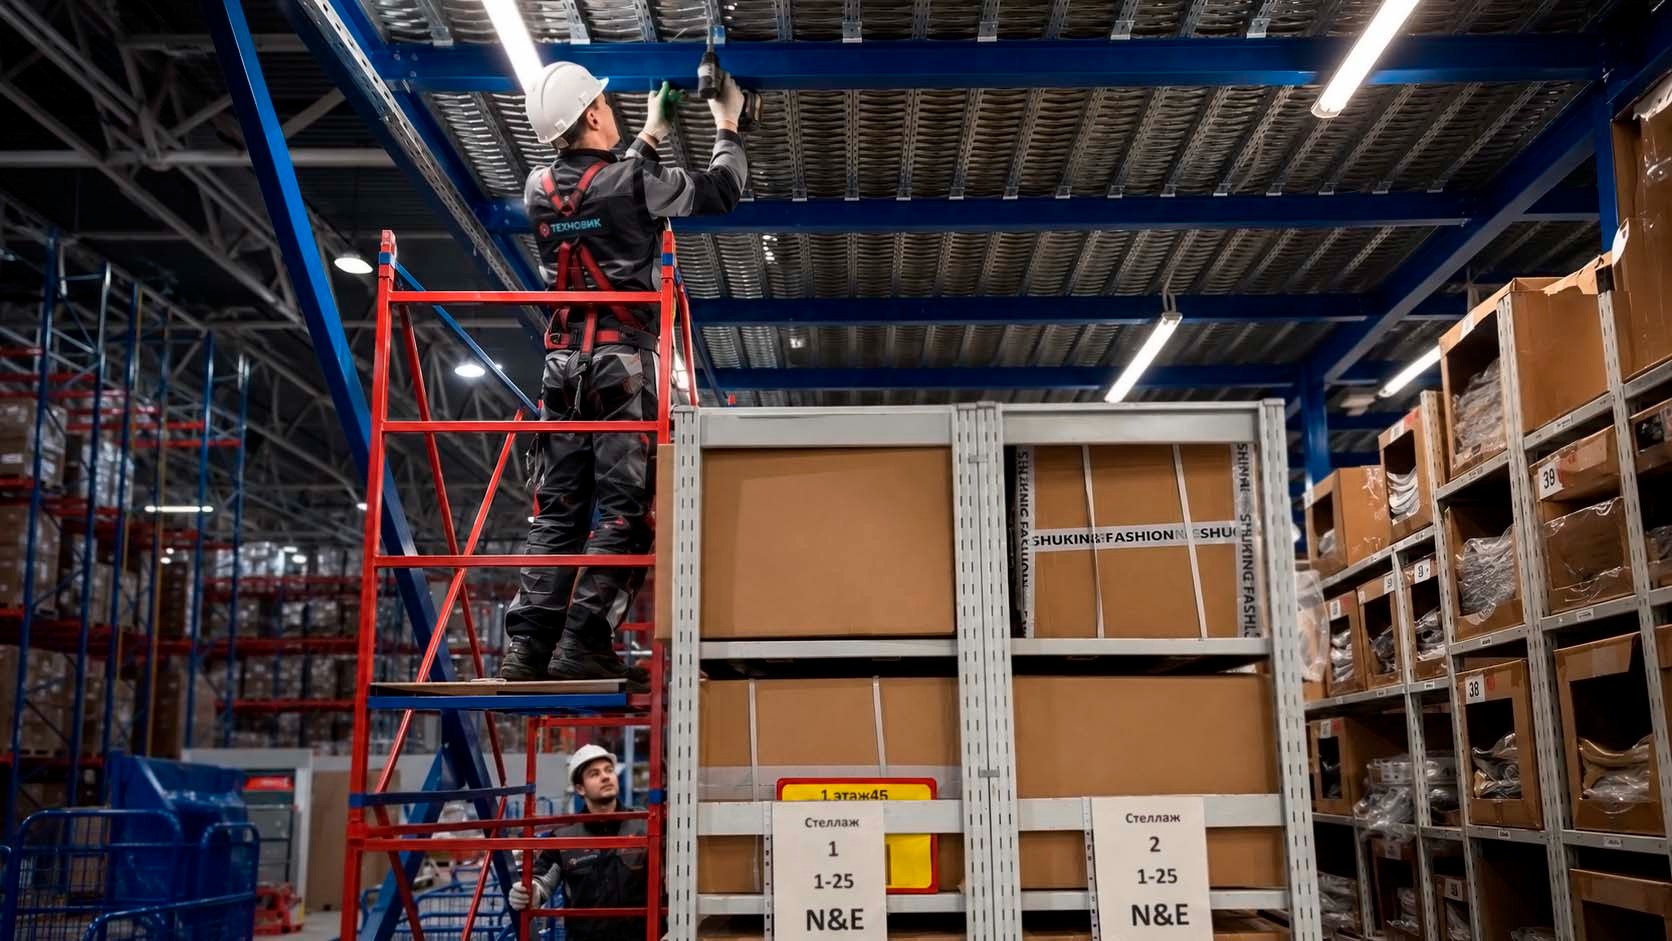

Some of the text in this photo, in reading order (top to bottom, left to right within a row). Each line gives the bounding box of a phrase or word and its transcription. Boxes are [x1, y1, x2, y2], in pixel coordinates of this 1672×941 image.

[550, 218, 602, 233] ТЕХНОВИК
[1543, 468, 1556, 489] 39
[1106, 529, 1174, 543] FASHION
[1469, 681, 1480, 698] 38
[804, 817, 860, 828] Стеллаж
[1125, 813, 1181, 824] Стеллаж
[828, 840, 839, 857] 1
[1149, 836, 1161, 852] 2
[814, 873, 854, 889] 1-25
[1137, 868, 1178, 885] 1-25
[806, 908, 864, 931] N&E
[1131, 903, 1190, 926] N&E
